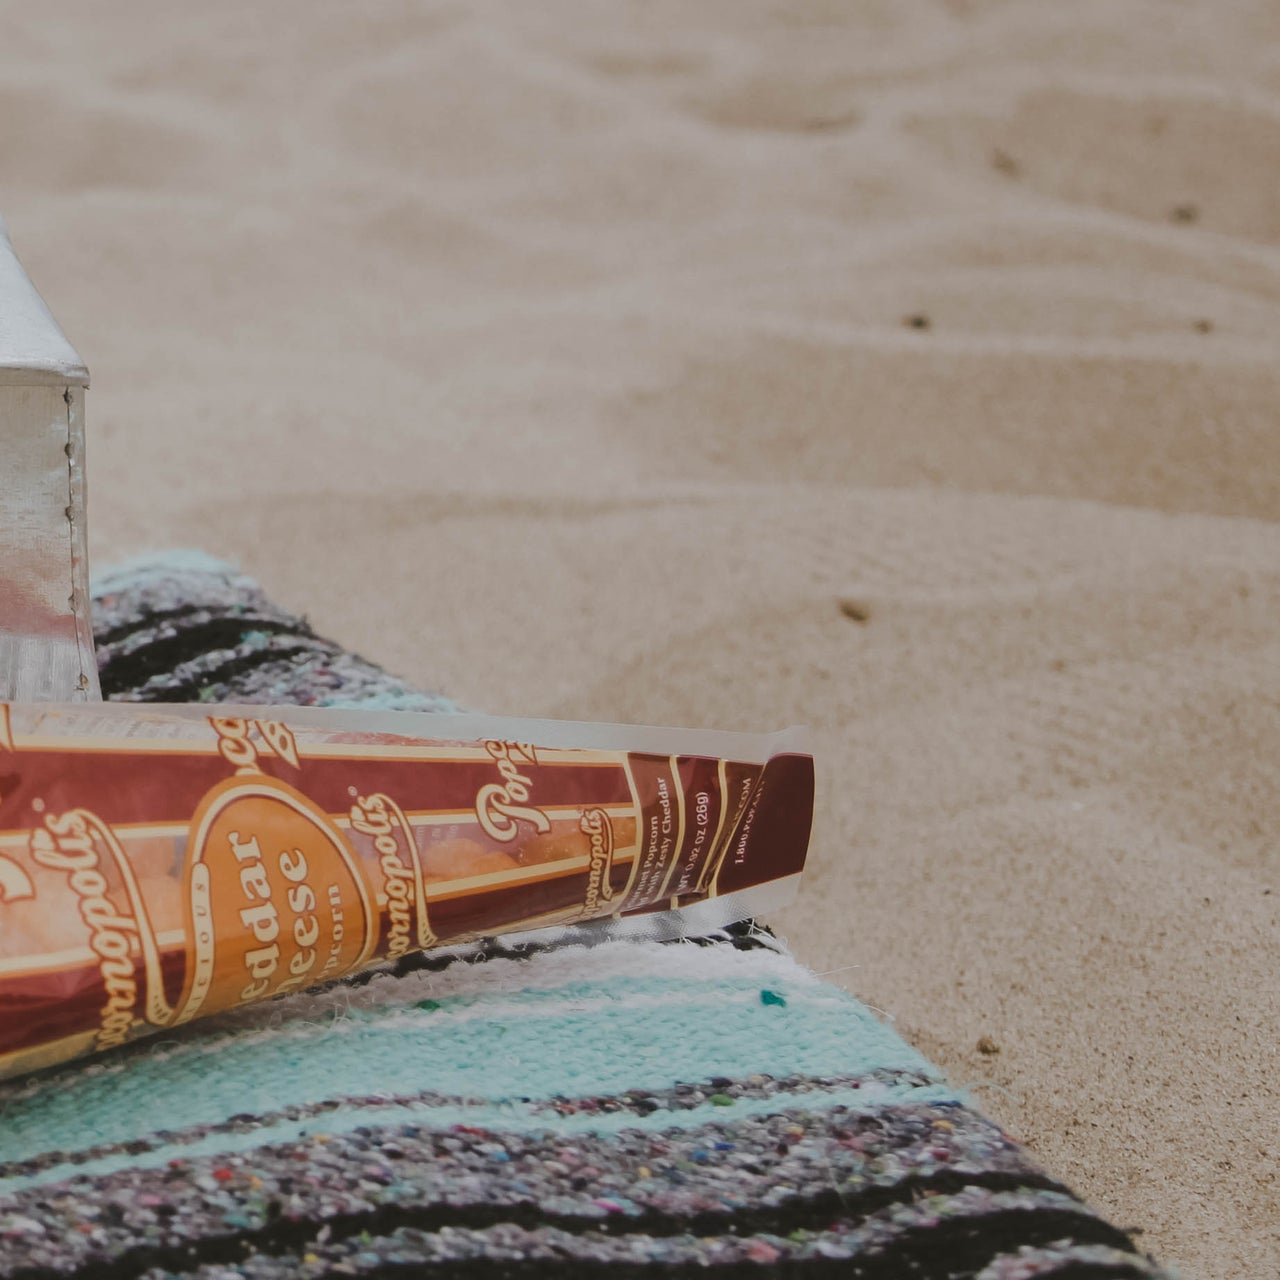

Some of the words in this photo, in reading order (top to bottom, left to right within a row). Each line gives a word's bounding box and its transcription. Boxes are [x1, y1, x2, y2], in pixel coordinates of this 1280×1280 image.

[657, 777, 672, 835] Cheddar
[695, 791, 710, 826] (26g)
[643, 815, 658, 869] Popcorn
[655, 837, 672, 868] Zesty
[694, 828, 706, 845] OZ
